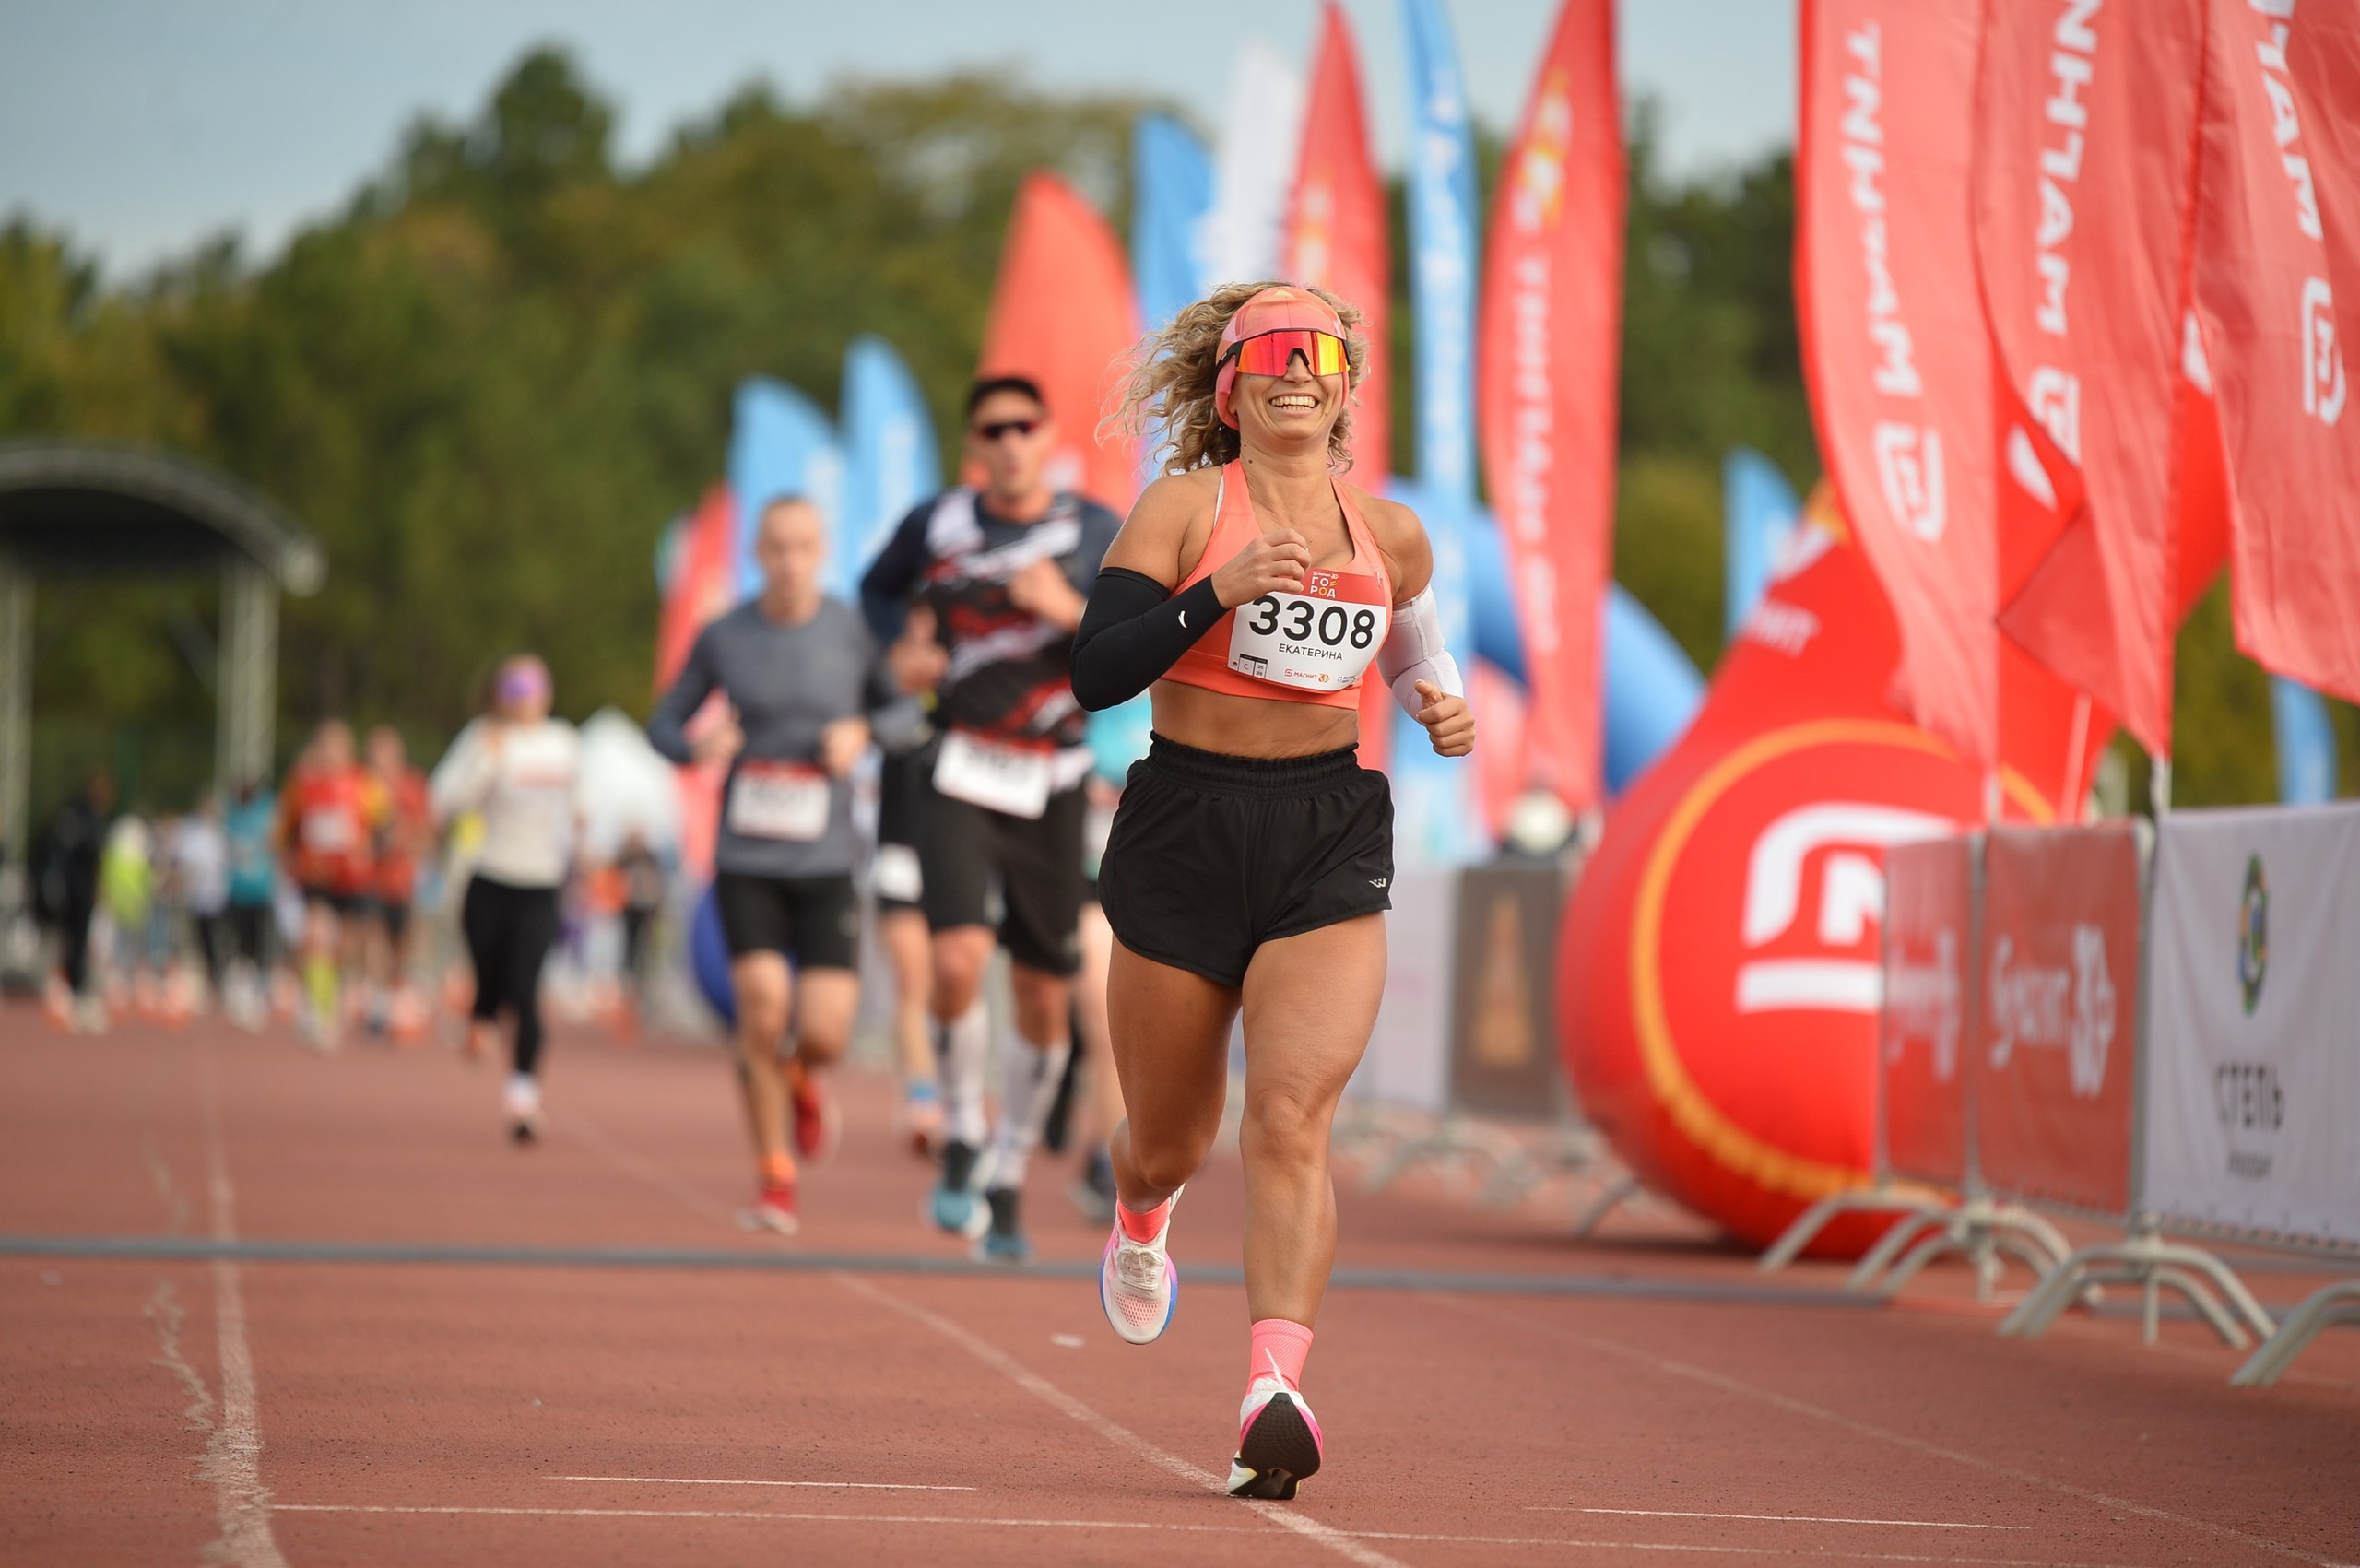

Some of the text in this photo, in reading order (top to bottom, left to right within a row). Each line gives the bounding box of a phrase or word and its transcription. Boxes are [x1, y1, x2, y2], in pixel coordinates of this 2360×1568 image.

[1310, 585, 1336, 599] РОД
[1249, 595, 1375, 650] 3308
[1279, 643, 1343, 661] ЕКАТЕРИНА
[1293, 671, 1317, 679] МАГНИТ
[2215, 1062, 2286, 1131] СТЕПЬ
